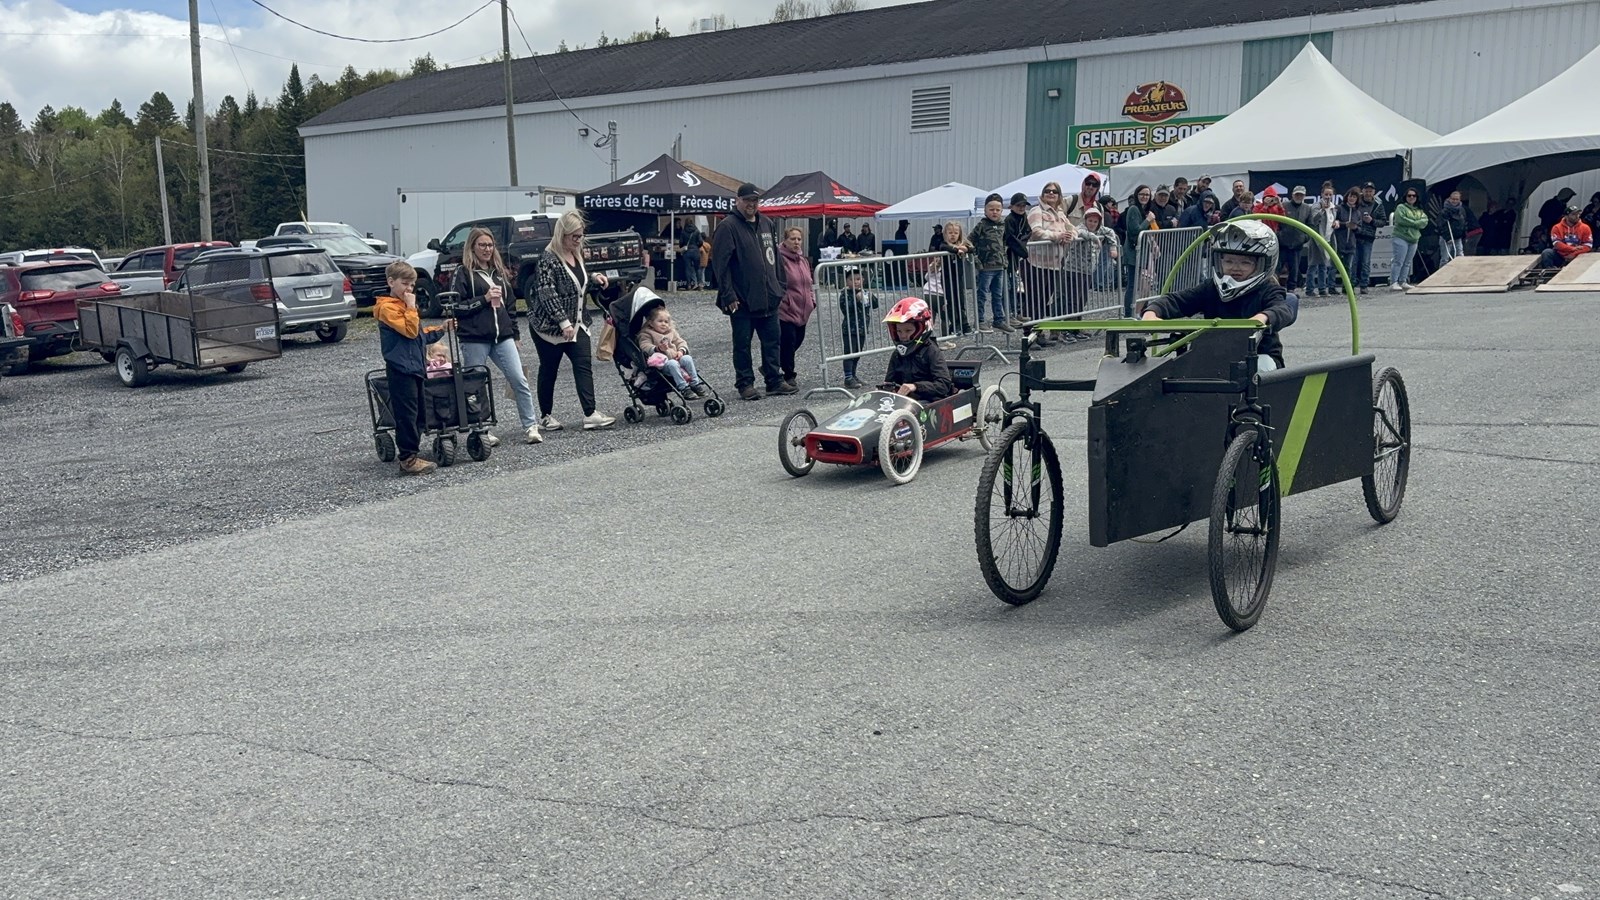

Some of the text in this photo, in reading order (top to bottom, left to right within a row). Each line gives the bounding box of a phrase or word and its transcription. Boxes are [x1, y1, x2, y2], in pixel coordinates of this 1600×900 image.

[1078, 124, 1211, 148] CENTRE SPOR
[1077, 153, 1098, 166] A.
[583, 194, 664, 208] Frères de Feu
[680, 195, 713, 209] Frères
[715, 197, 728, 210] de
[730, 198, 737, 211] F
